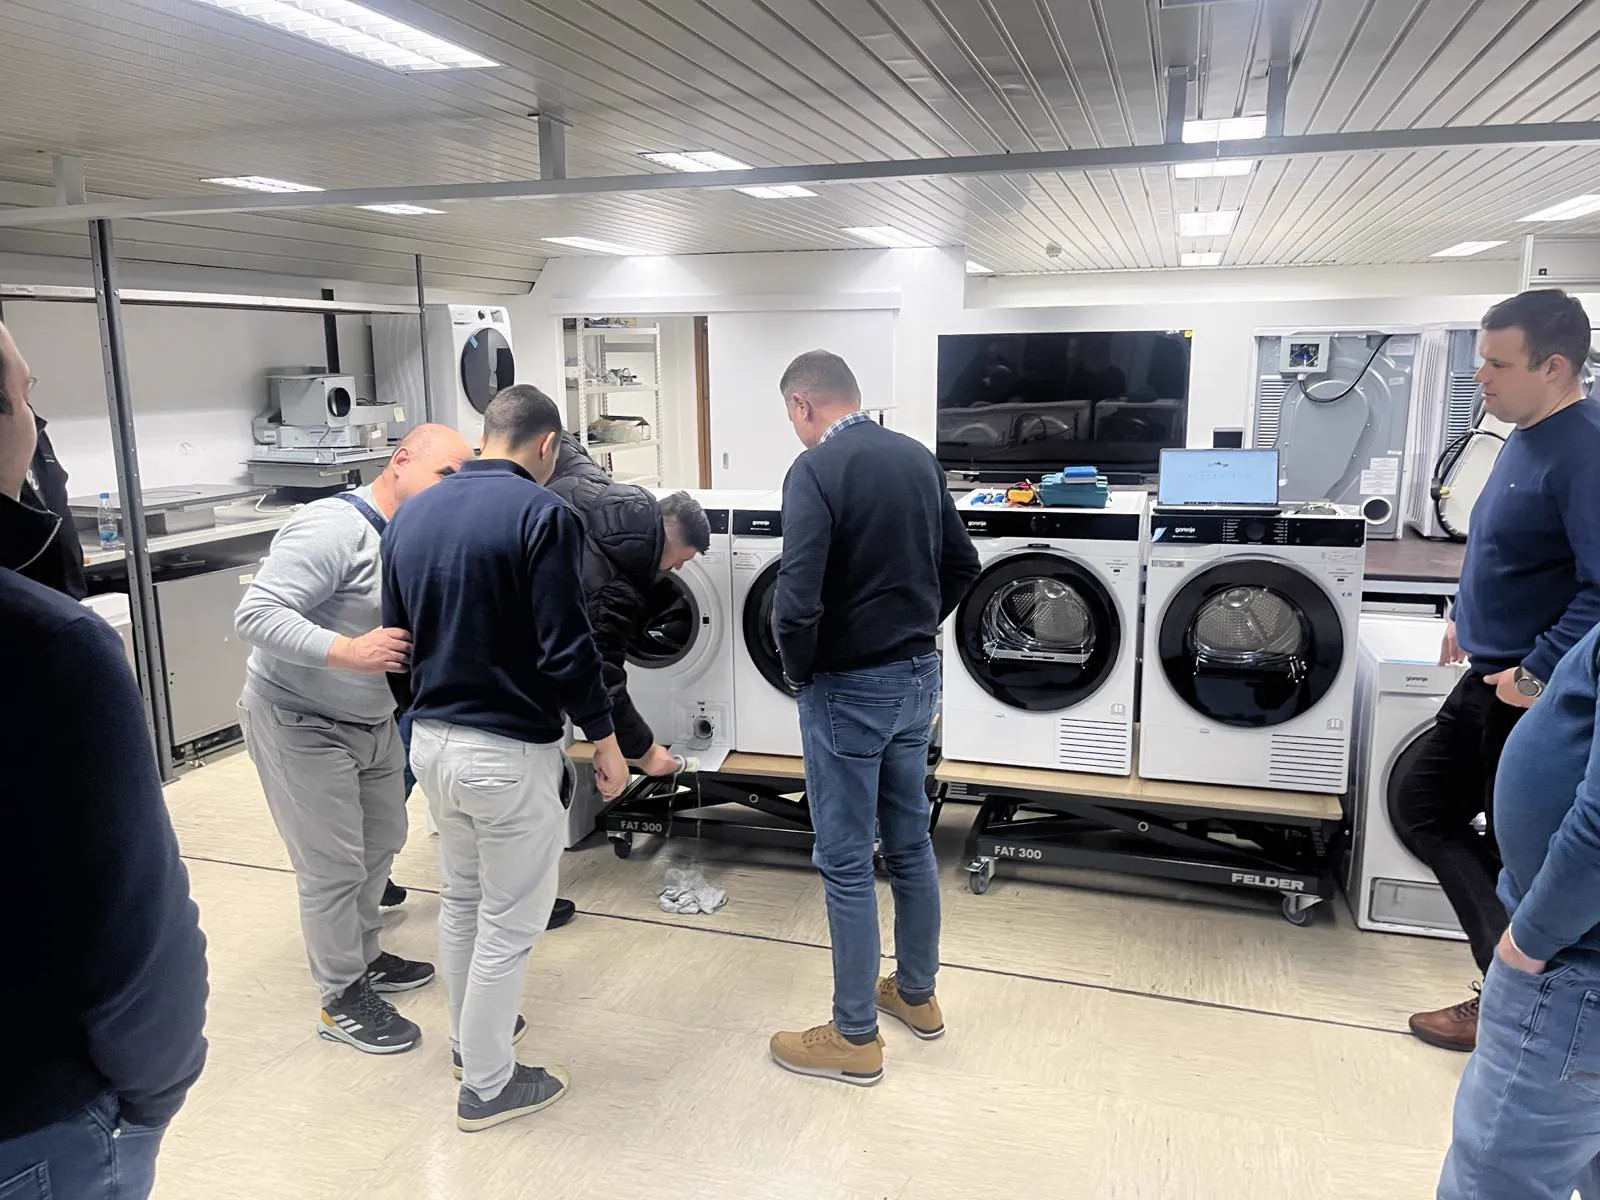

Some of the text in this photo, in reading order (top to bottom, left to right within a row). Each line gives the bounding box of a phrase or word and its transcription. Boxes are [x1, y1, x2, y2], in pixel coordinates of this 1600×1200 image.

[620, 820, 662, 832] FAT 300
[994, 845, 1042, 860] FAT 300
[1231, 872, 1304, 891] FELDER
